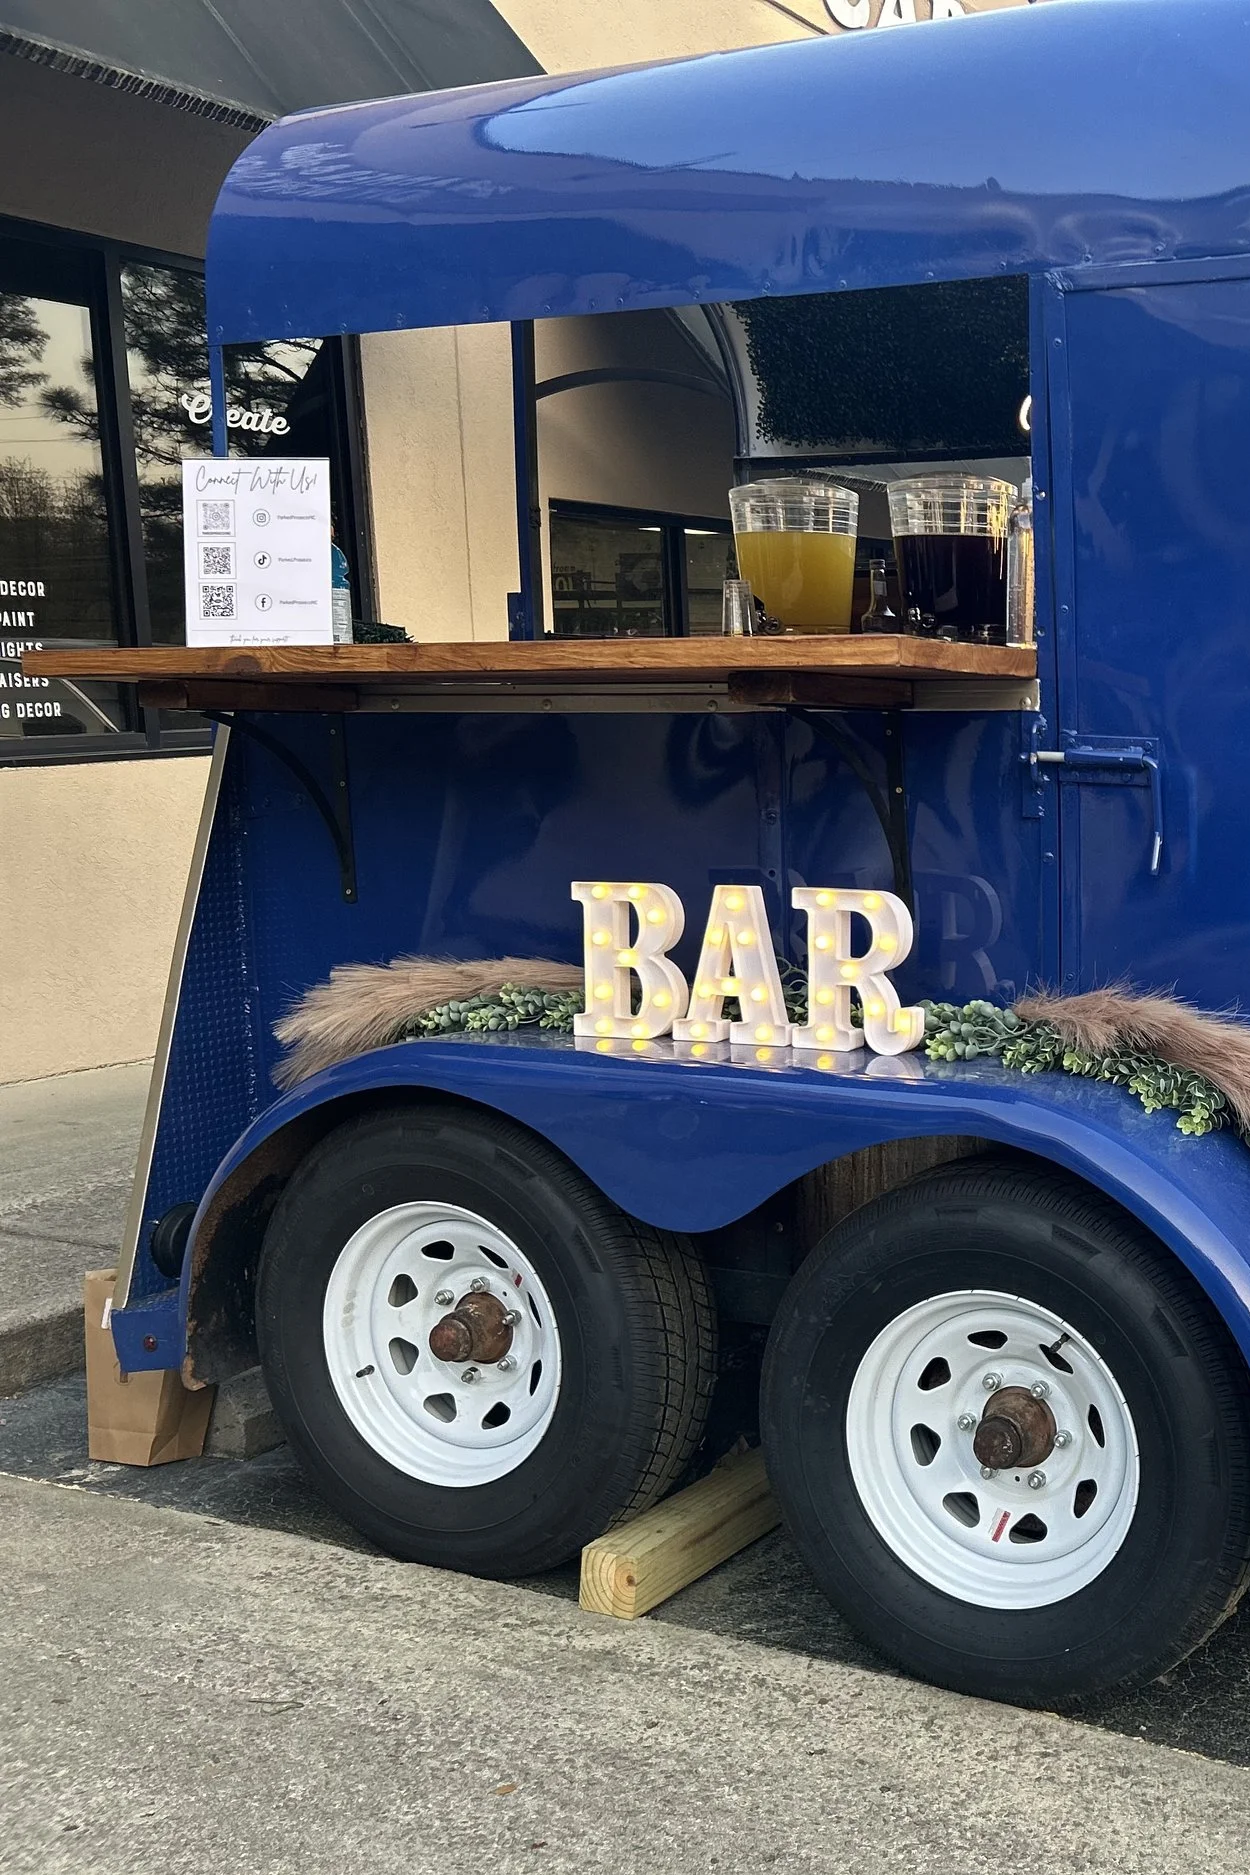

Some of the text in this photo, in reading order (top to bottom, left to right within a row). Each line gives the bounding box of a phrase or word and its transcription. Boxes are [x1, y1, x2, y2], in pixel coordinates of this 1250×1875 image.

[181, 392, 291, 436] Ceate
[196, 465, 252, 495] Connect
[250, 466, 290, 495] With
[0, 580, 45, 597] DECOR
[0, 611, 35, 627] AINT
[16, 702, 62, 719] DECOR
[570, 880, 925, 1056] BAR
